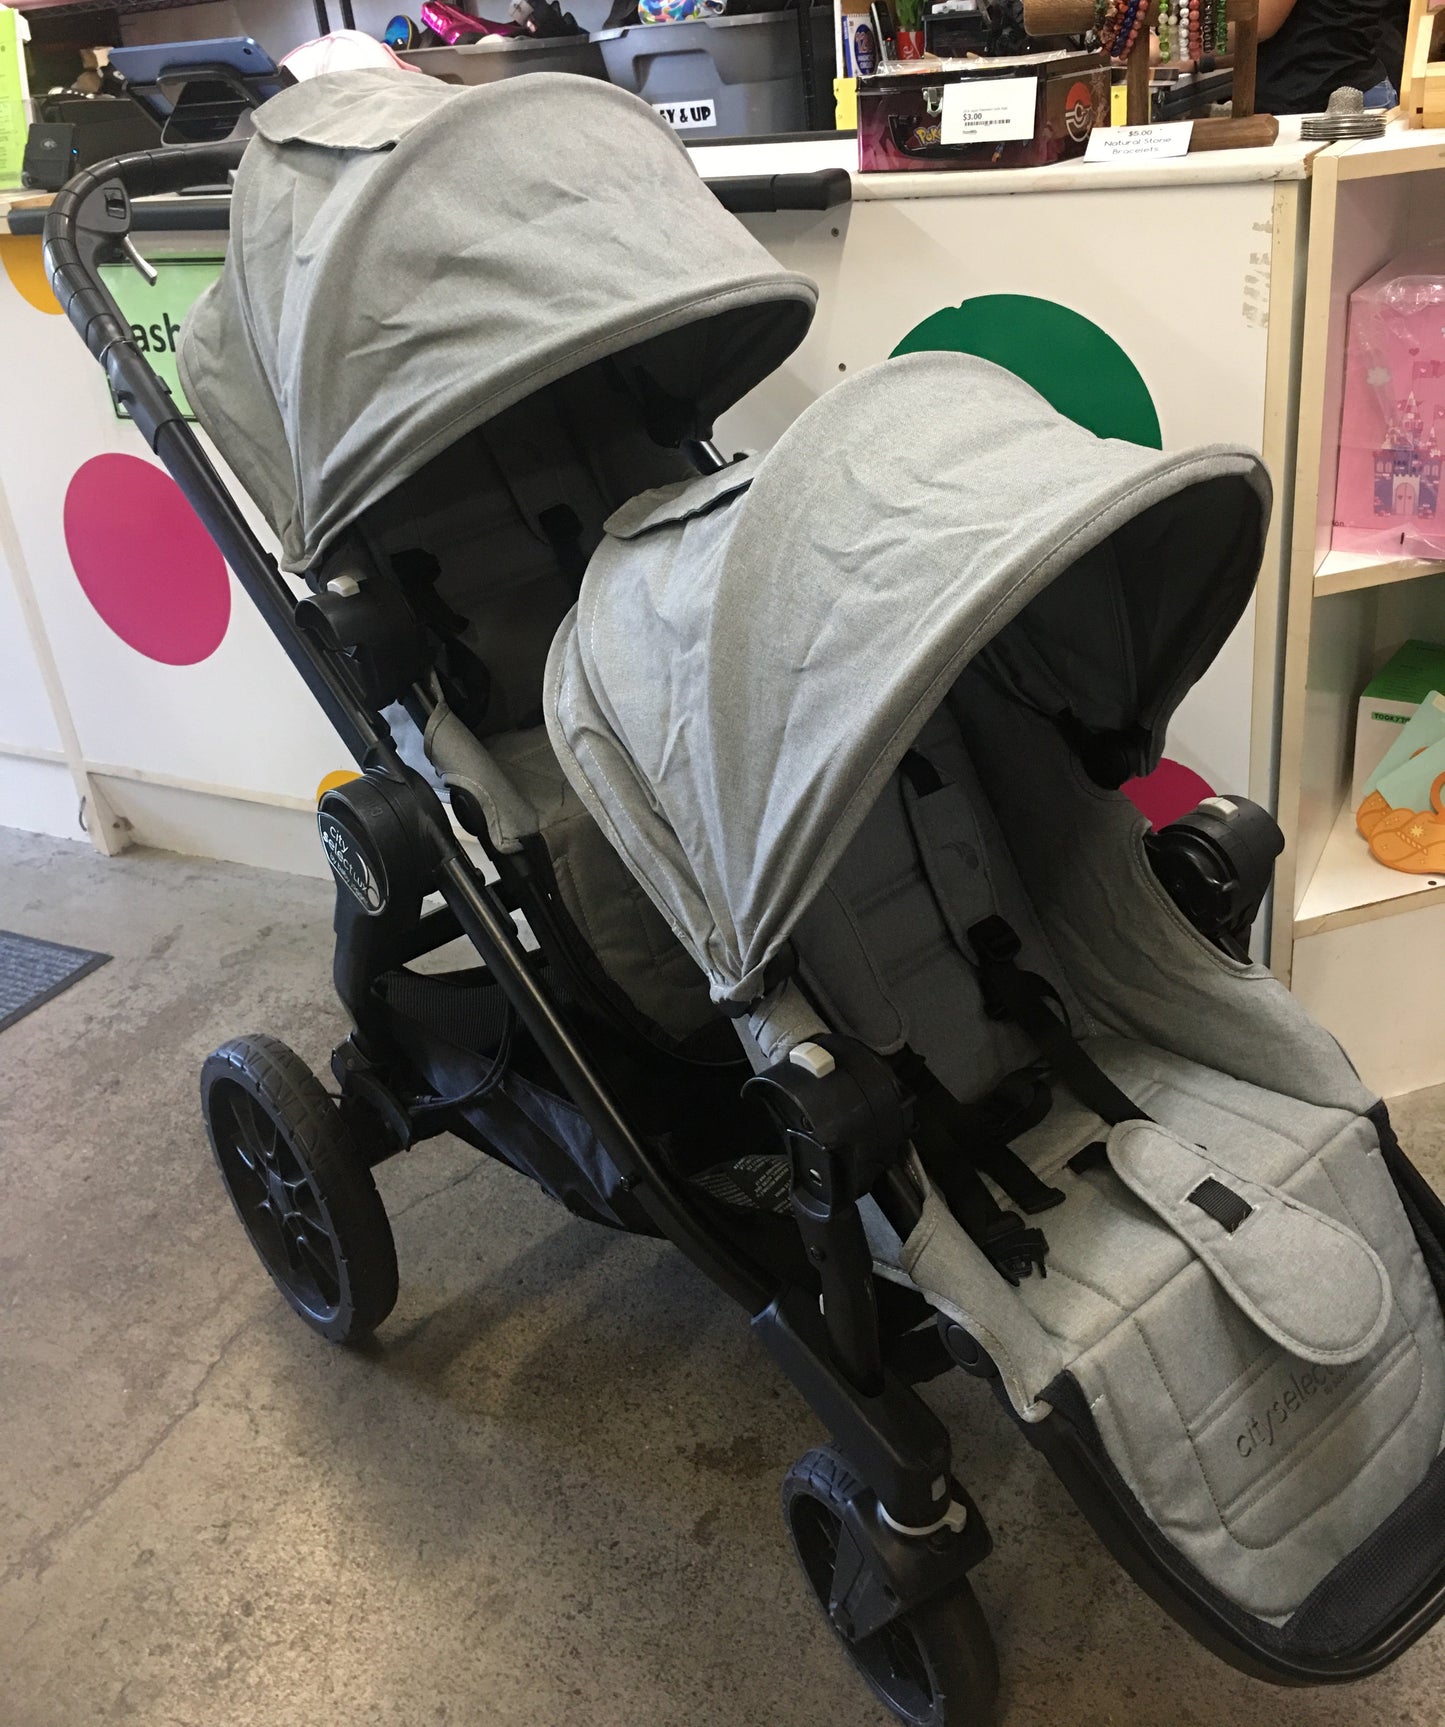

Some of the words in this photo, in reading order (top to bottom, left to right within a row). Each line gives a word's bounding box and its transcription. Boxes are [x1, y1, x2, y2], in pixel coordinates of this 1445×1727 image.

[680, 108, 688, 123] &
[690, 106, 711, 121] UP
[962, 113, 983, 121] $3.00
[1104, 138, 1142, 147] Natural
[1112, 147, 1159, 155] Bracelets
[131, 312, 181, 353] ash
[329, 826, 349, 853] city
[322, 831, 353, 876] select
[1236, 1364, 1329, 1458] cityselec
